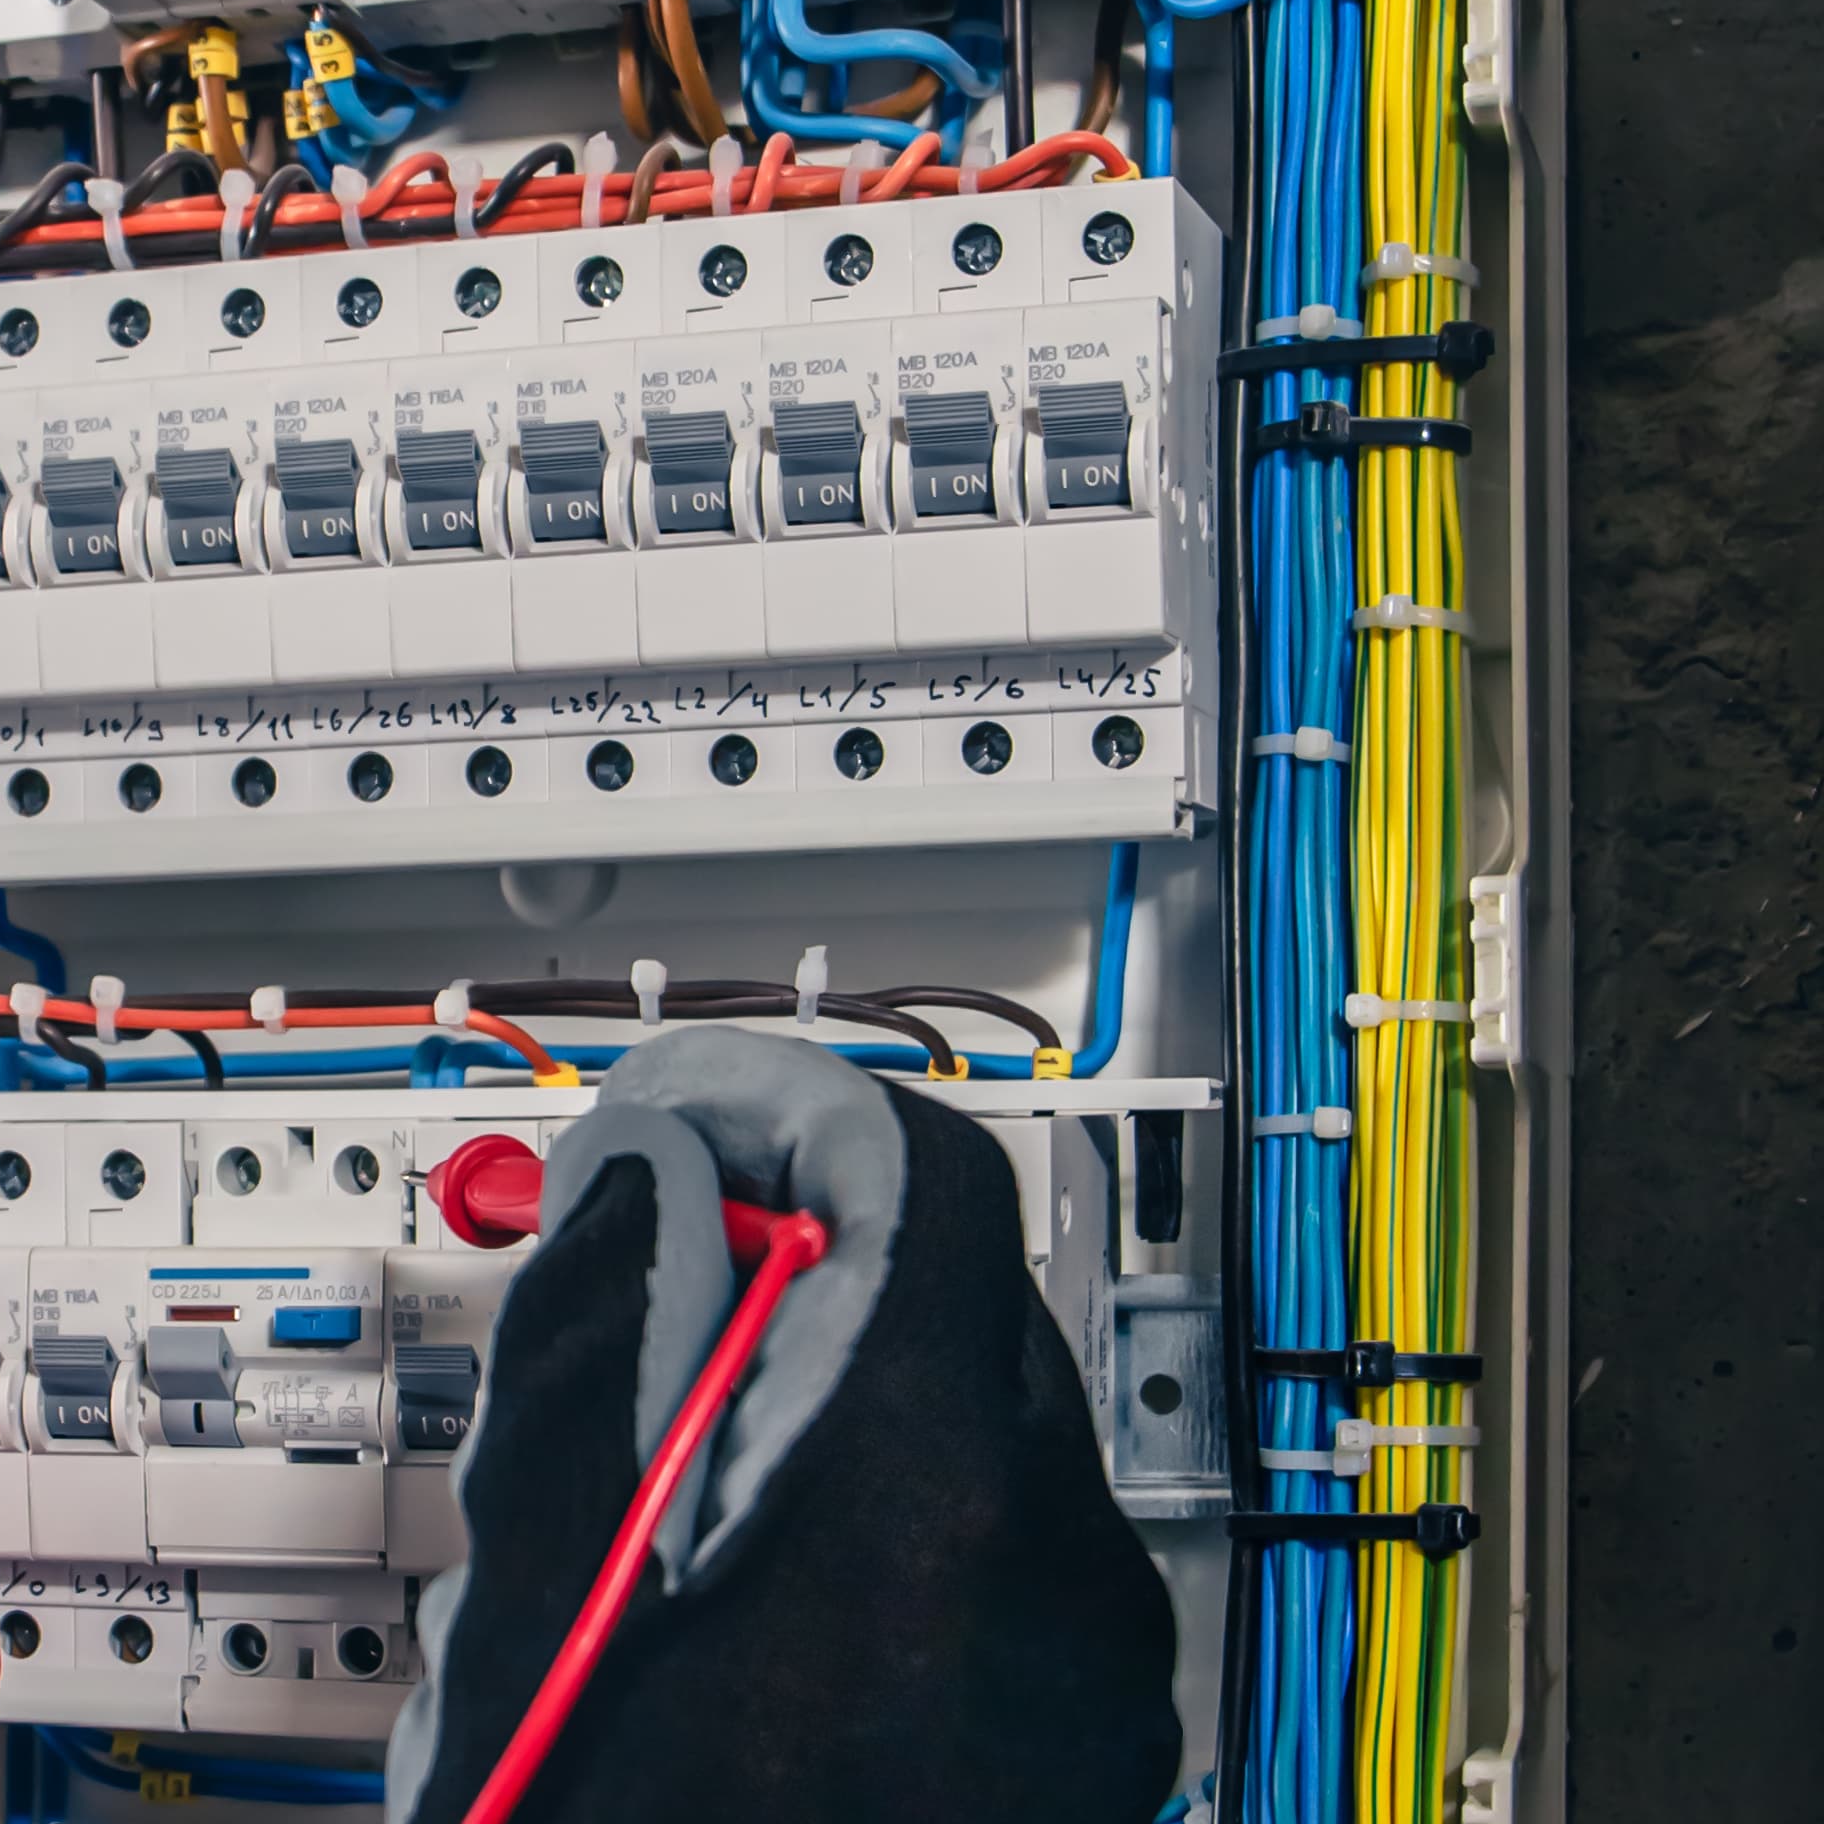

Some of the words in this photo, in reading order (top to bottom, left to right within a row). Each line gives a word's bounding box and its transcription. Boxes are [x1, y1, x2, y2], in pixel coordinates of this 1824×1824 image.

[934, 351, 977, 367] 120A
[1066, 342, 1110, 359] 120A
[804, 358, 848, 375] 120A
[1028, 363, 1066, 380] B20
[676, 368, 718, 384] 120A
[898, 372, 934, 389] B20
[769, 379, 805, 395] B20
[307, 397, 346, 413] 120A
[641, 389, 676, 406] B20
[191, 407, 228, 423] 120A
[76, 417, 112, 433] 120A
[275, 418, 307, 434] B20
[158, 426, 190, 443] B20
[43, 436, 74, 451] B20
[953, 474, 987, 495] ON
[1084, 465, 1120, 487] ON
[692, 491, 725, 513] ON
[819, 484, 855, 506] ON
[567, 501, 600, 521] ON
[443, 511, 475, 531] ON
[201, 527, 233, 547] ON
[391, 1130, 408, 1150] N
[360, 1285, 372, 1300] A
[346, 1383, 358, 1400] A
[78, 1406, 110, 1423] ON
[194, 1653, 207, 1672] 2
